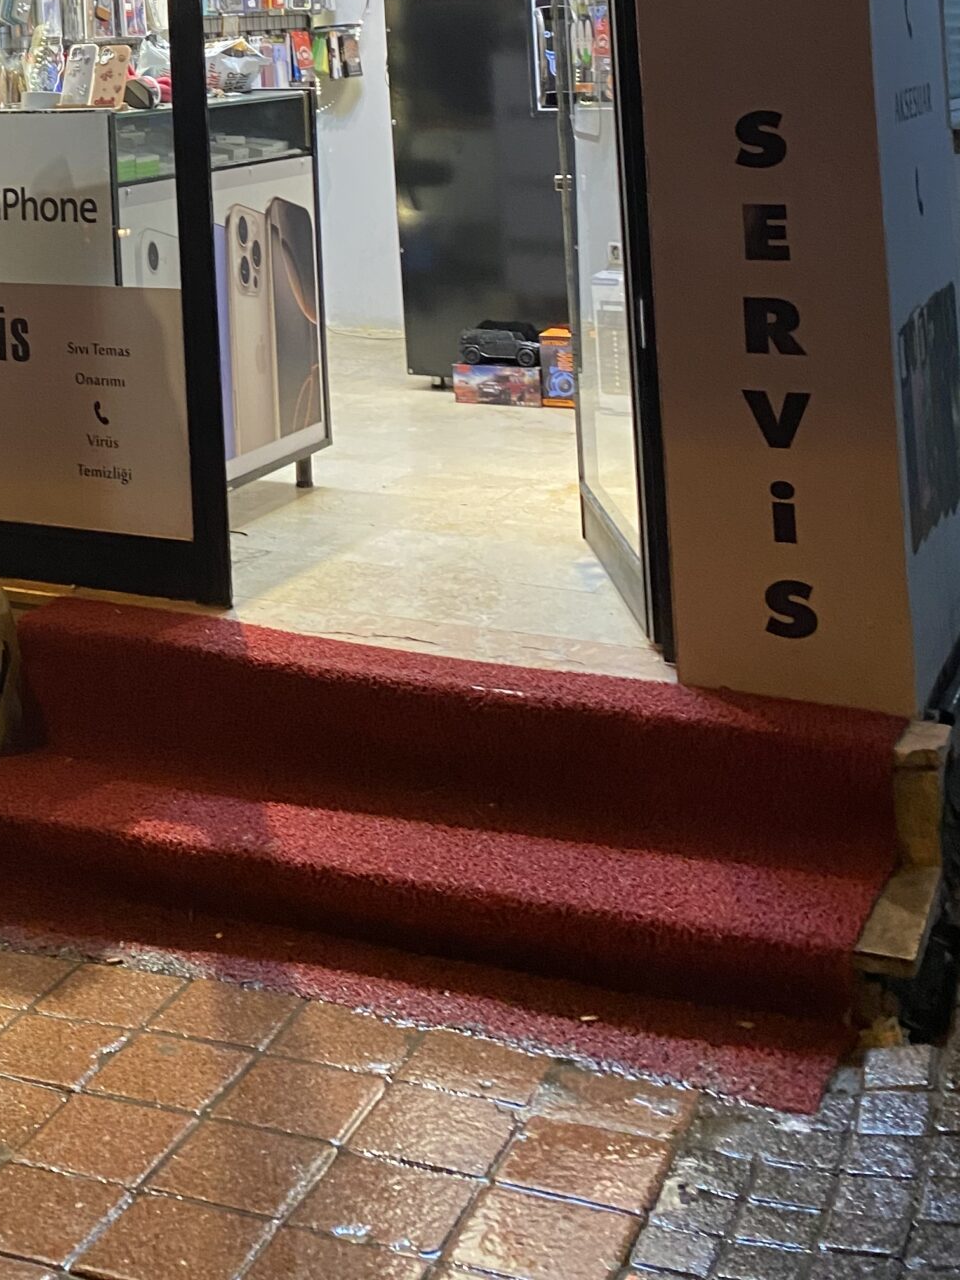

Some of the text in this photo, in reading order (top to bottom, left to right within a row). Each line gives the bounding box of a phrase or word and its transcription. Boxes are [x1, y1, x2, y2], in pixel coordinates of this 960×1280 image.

[91, 342, 131, 357] Temas
[75, 372, 126, 387] Onarımı
[86, 433, 120, 449] Virüs
[77, 463, 133, 485] Temizliği
